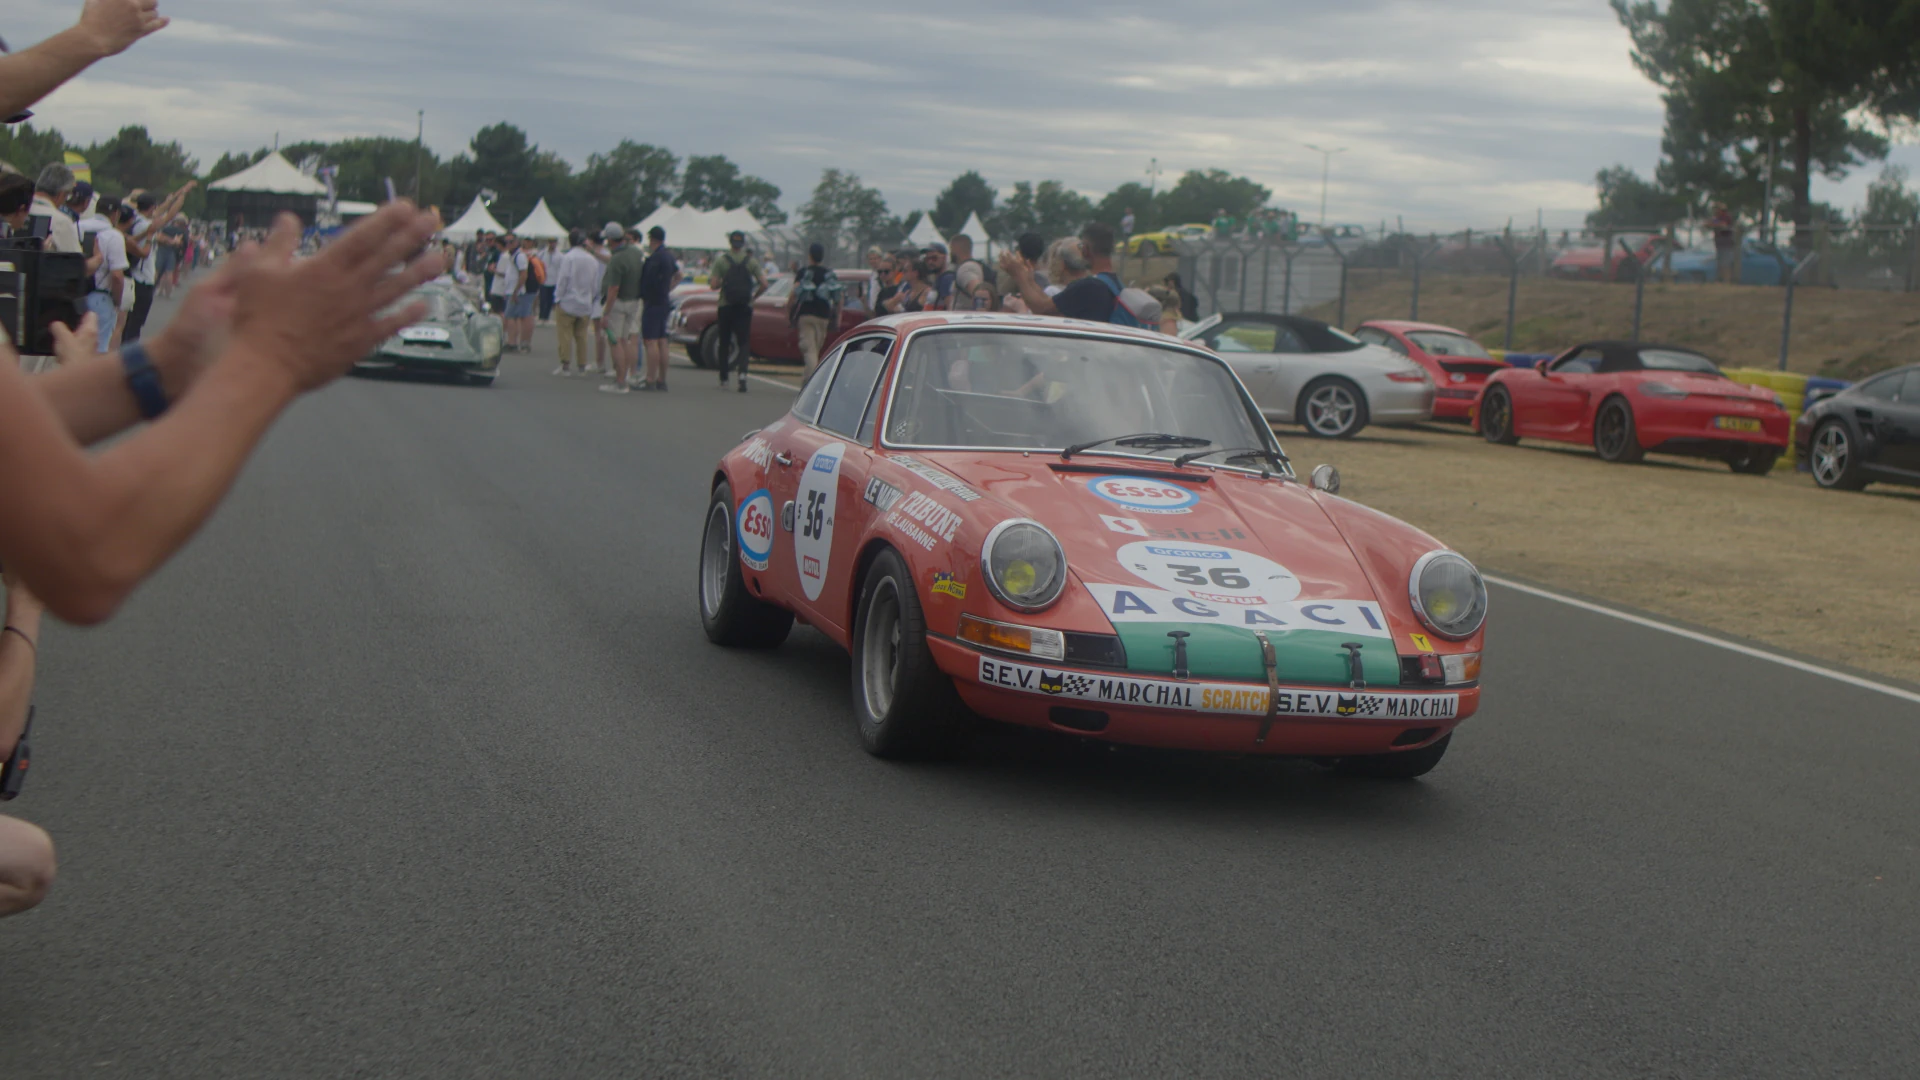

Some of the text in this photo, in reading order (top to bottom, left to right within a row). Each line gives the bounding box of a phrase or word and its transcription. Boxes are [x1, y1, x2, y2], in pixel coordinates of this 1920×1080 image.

[863, 477, 881, 504] LE
[803, 489, 827, 540] 36
[898, 490, 963, 543] TRIBUNE
[887, 511, 937, 552] DE LAUSANNE
[1153, 548, 1224, 559] aramco
[804, 558, 820, 577] MOTUL
[1166, 563, 1250, 589] 36
[1112, 590, 1382, 630] AGACI
[1194, 592, 1263, 604] MOTUL
[982, 661, 1192, 707] S.E.V. MARCHAL
[1202, 688, 1270, 713] SCRATCH
[1277, 693, 1454, 717] S.E.V. MARCHAL
